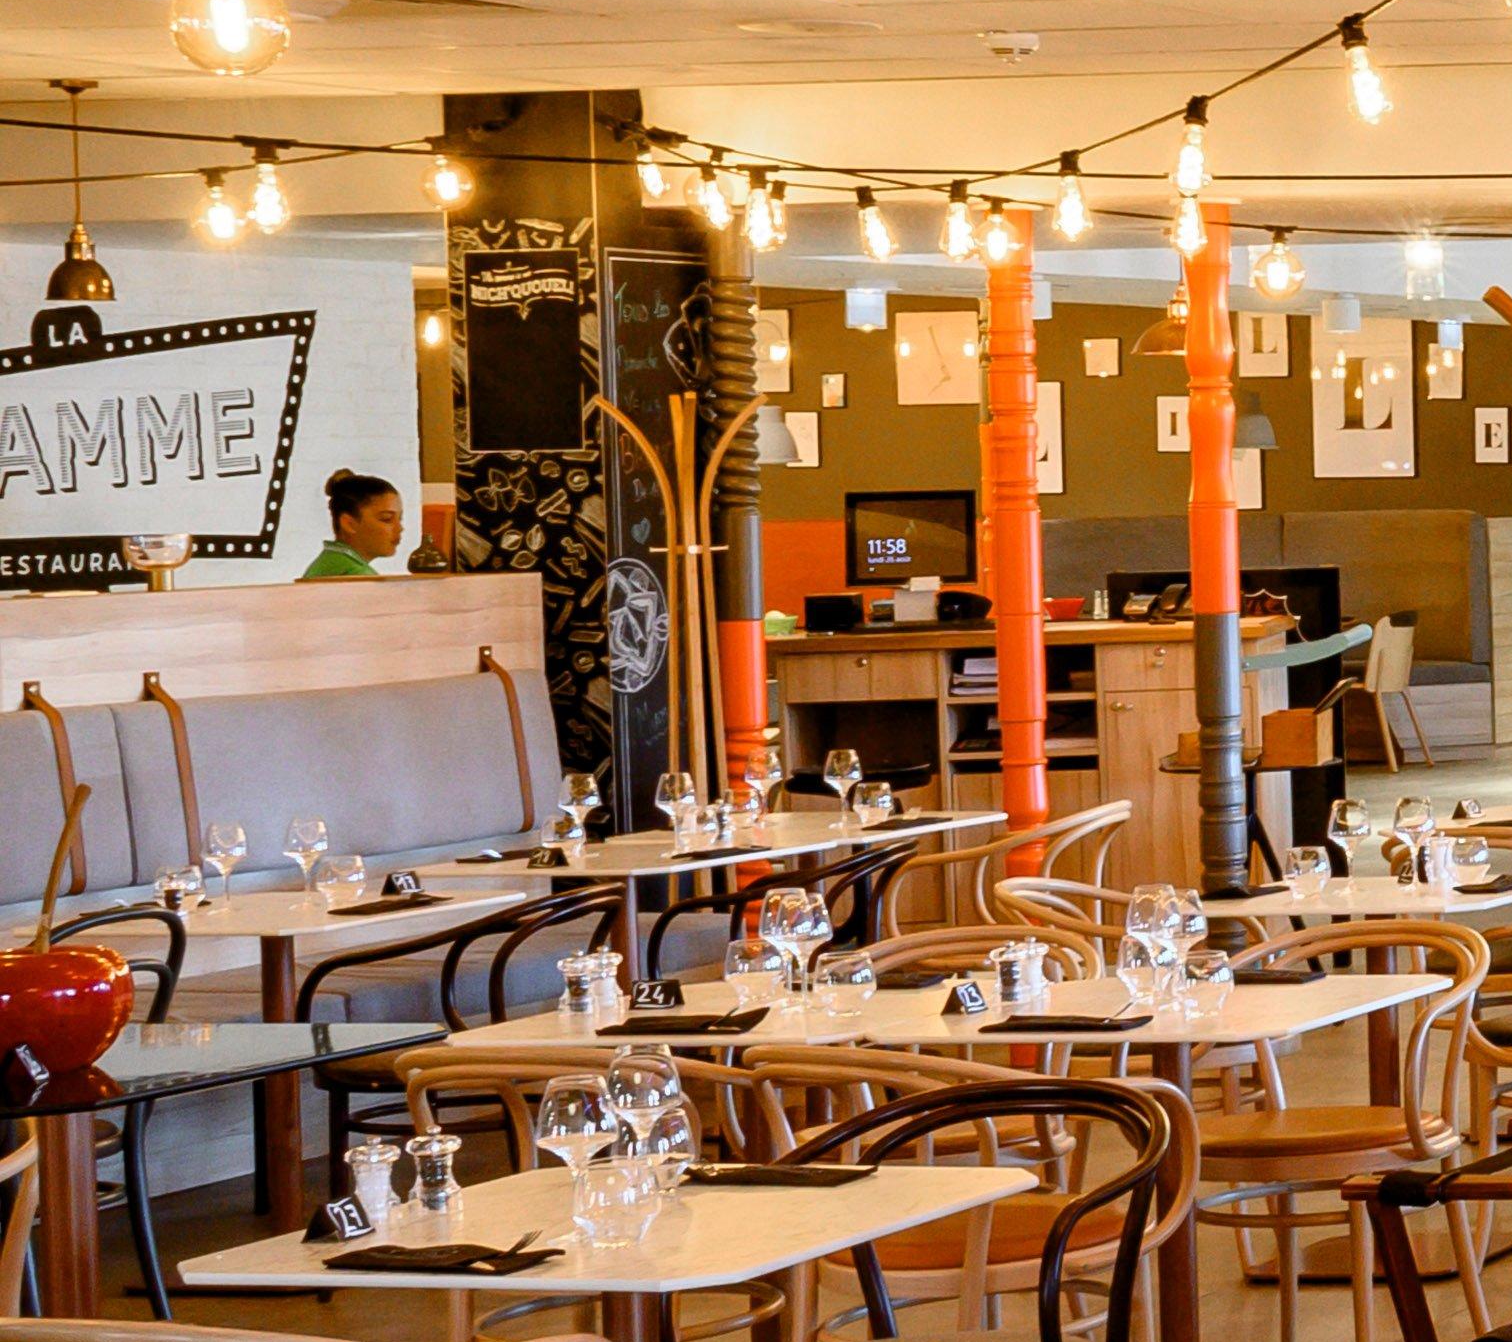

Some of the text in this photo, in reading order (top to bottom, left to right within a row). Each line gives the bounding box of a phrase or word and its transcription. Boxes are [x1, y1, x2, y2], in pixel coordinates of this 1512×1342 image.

[49, 323, 88, 348] LA
[1337, 358, 1394, 430] L
[0, 388, 261, 499] AMME
[1483, 423, 1503, 449] E
[868, 539, 907, 554] 11:58
[637, 983, 665, 1005] 24
[959, 986, 984, 1007] 13
